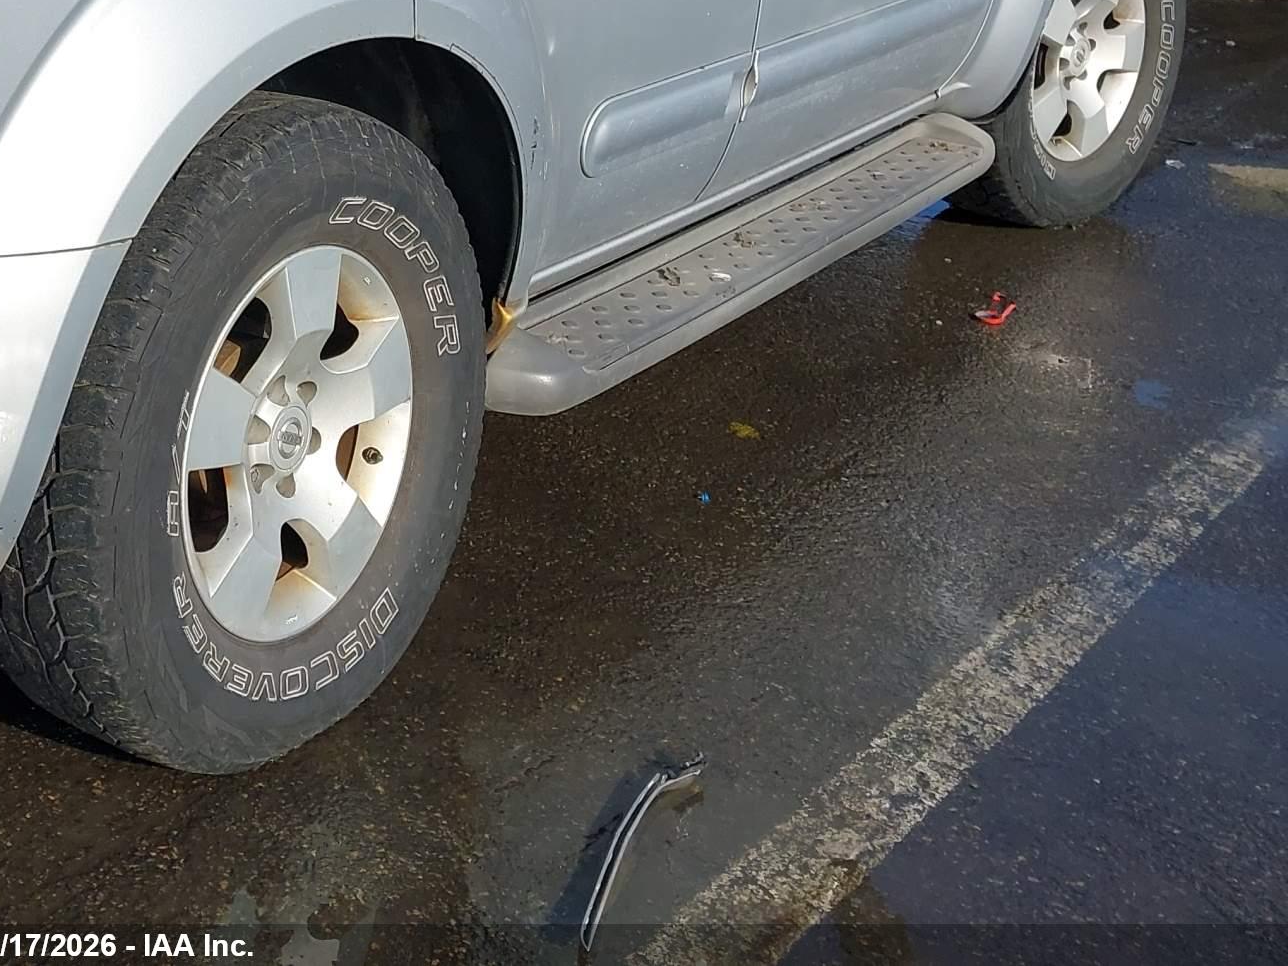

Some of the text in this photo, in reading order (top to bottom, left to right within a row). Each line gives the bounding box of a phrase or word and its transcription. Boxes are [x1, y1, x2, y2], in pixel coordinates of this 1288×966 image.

[1125, 0, 1176, 155] COOPER
[329, 196, 461, 358] COOPER
[173, 571, 400, 702] DISCOVERER
